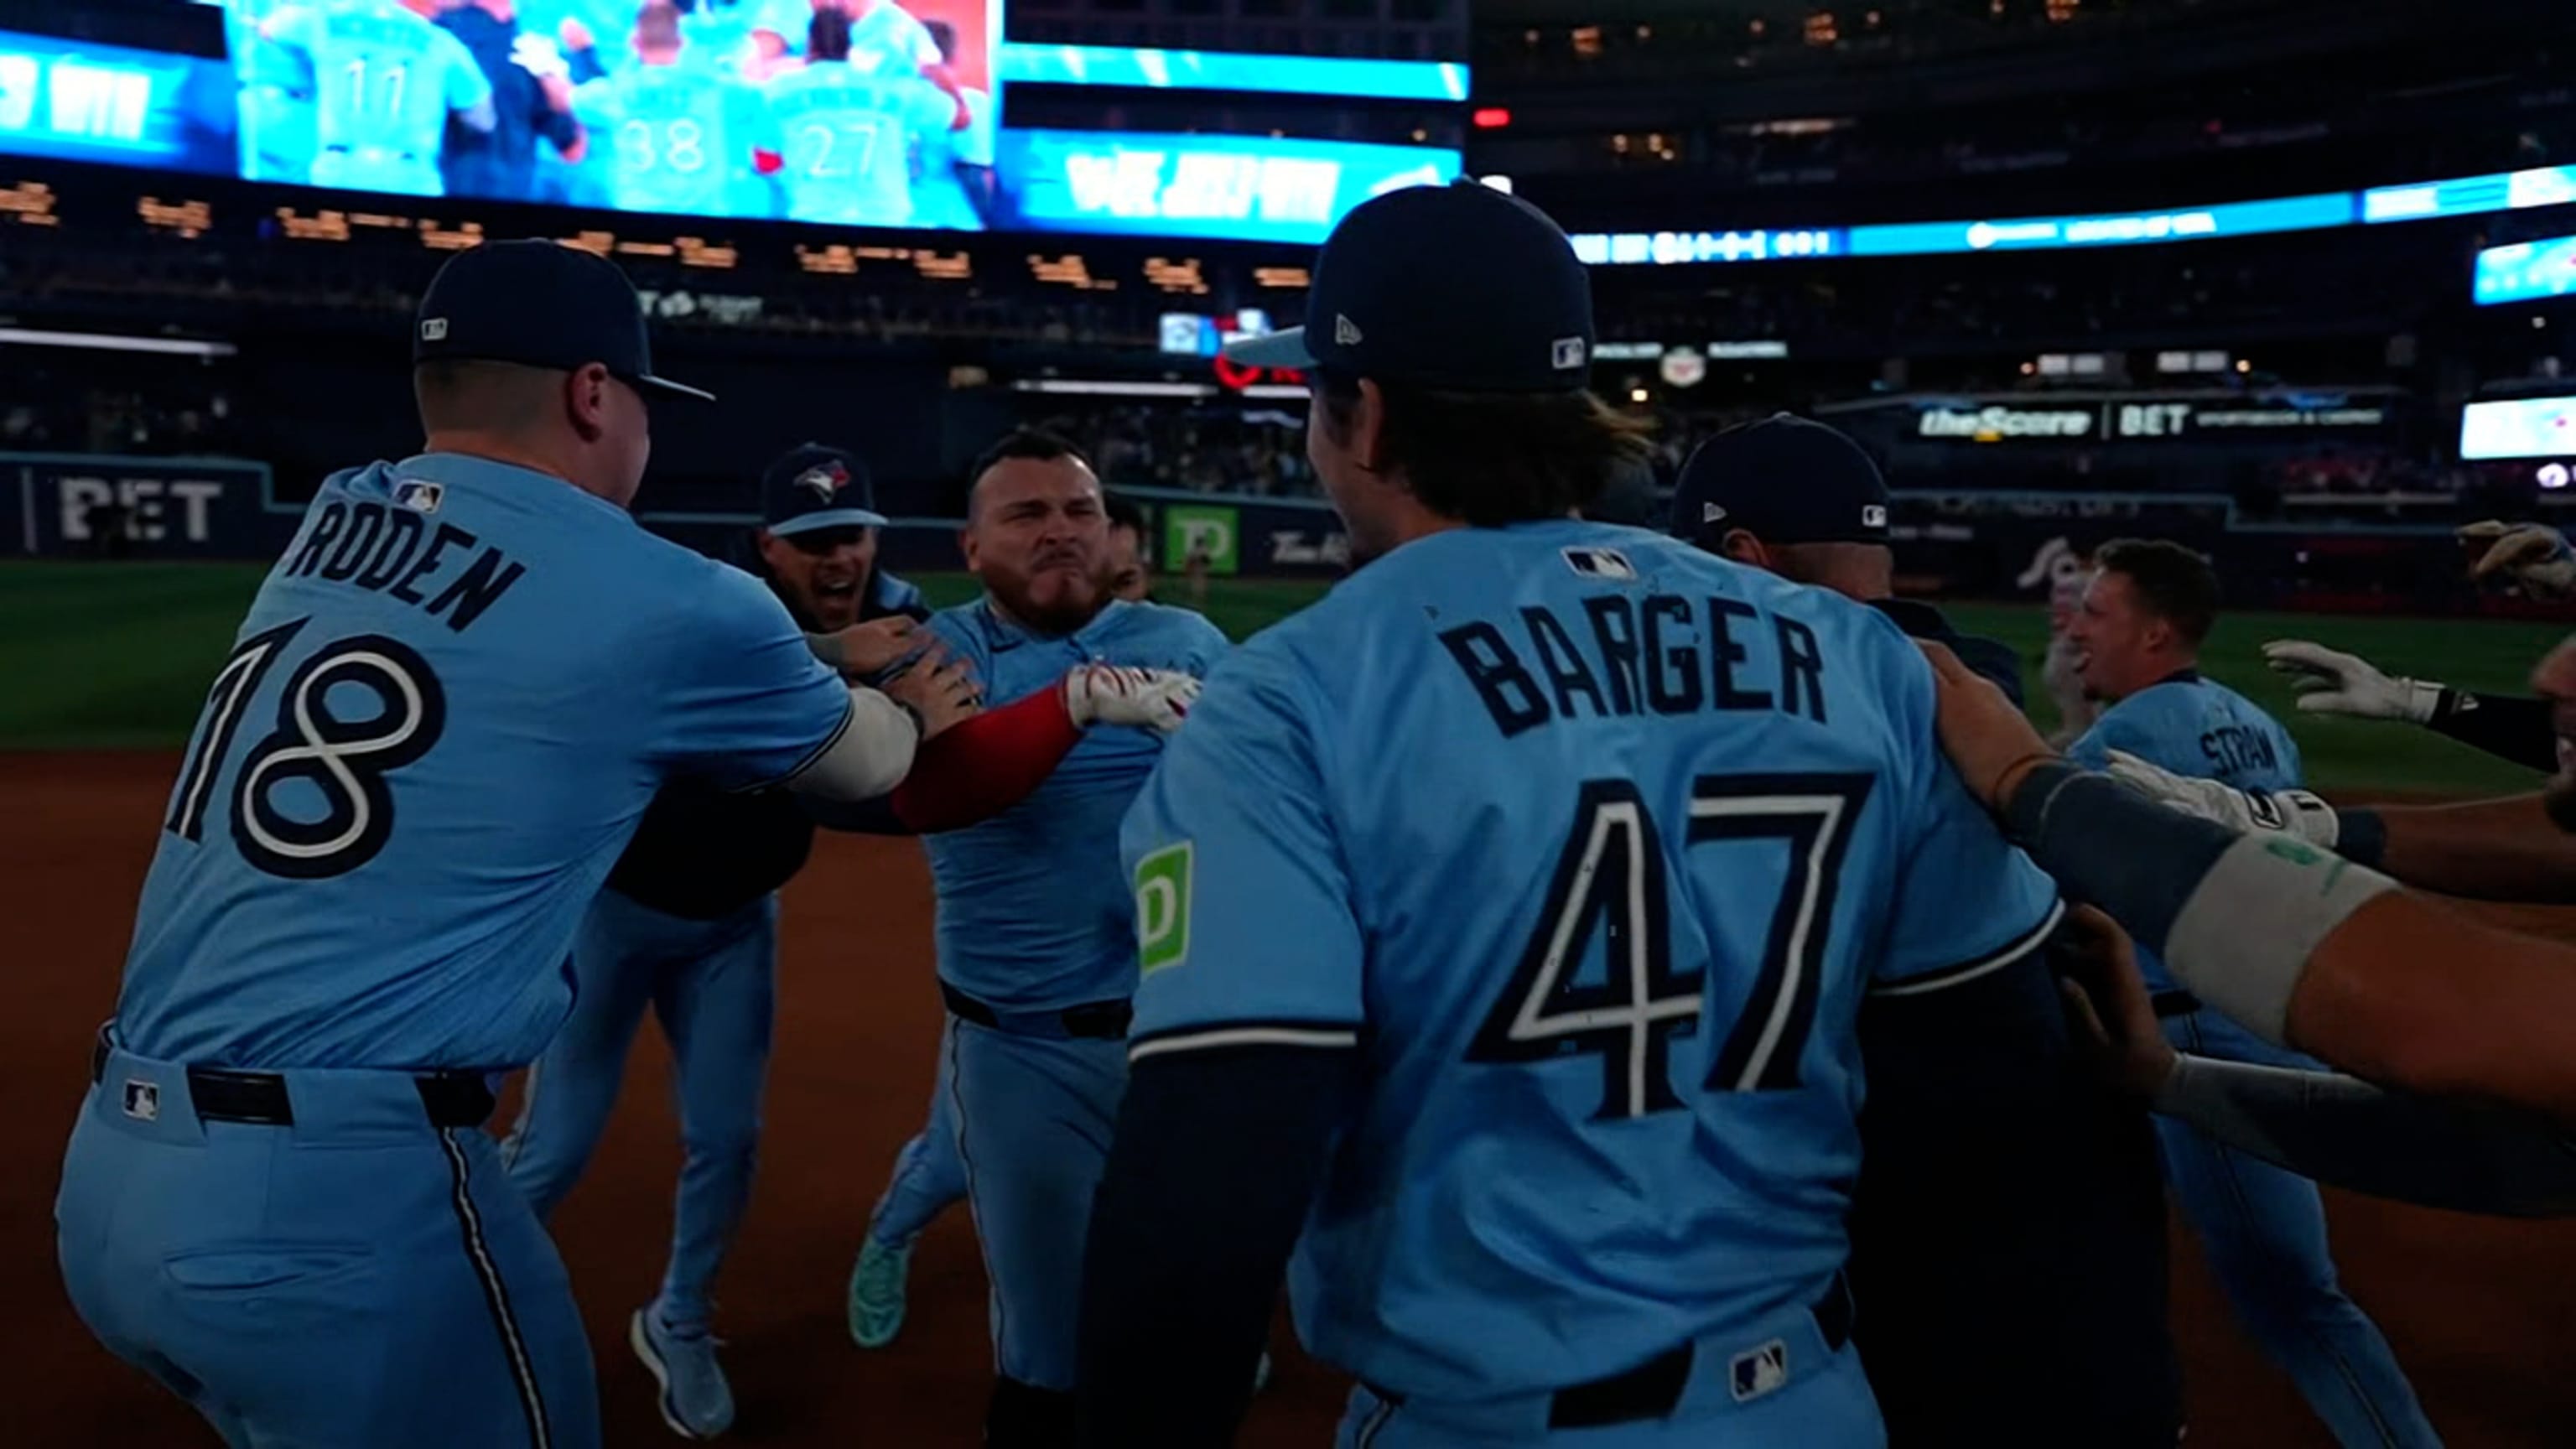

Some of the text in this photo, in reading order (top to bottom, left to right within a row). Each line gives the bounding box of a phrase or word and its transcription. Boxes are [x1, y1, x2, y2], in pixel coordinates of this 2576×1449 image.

[625, 120, 704, 174] 38
[802, 124, 878, 176] 27
[2120, 406, 2191, 436] BET
[285, 501, 527, 633] RODEN
[1437, 594, 1827, 740] BARGER
[166, 615, 446, 880] 18
[1461, 771, 1876, 1123] 47
